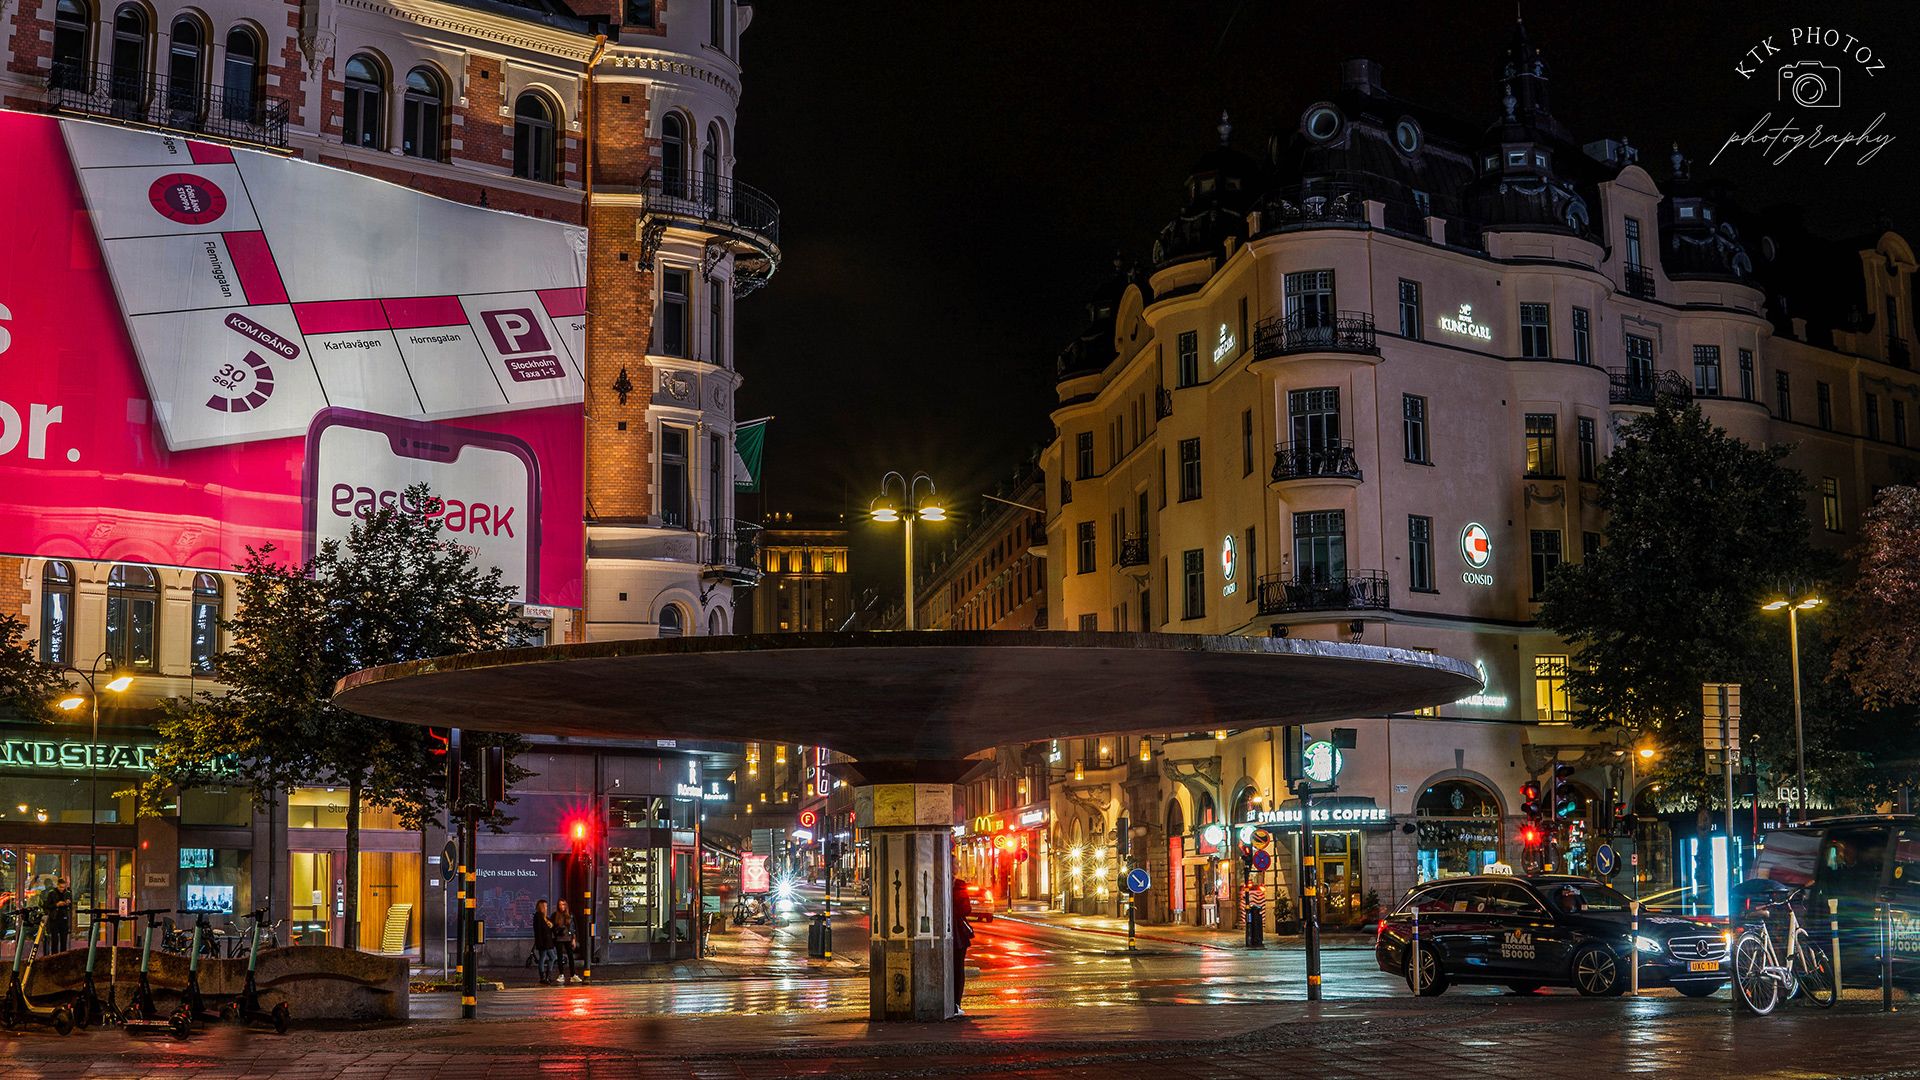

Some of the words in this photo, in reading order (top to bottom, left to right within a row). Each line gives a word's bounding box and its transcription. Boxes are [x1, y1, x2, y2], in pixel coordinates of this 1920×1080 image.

[177, 187, 192, 211] STOPPA
[204, 241, 232, 298] Fleminggatan
[230, 317, 259, 336] KOM
[494, 313, 531, 352] P
[1440, 317, 1467, 334] KUNG
[1468, 324, 1492, 340] CARL
[323, 339, 382, 350] Karlavägen
[409, 333, 461, 345] Hornsgatan
[510, 359, 556, 371] Stockholm
[219, 363, 247, 383] 30
[519, 369, 541, 379] Taxa
[540, 367, 556, 376] 1-5
[212, 375, 238, 391] sek
[1462, 572, 1493, 586] CONSID
[1258, 809, 1330, 823] STARBUKS
[1332, 808, 1387, 821] COFFEE
[497, 869, 516, 877] stans
[517, 868, 538, 877] bästa.
[1504, 932, 1532, 945] TAXI
[1501, 943, 1536, 951] STOCKHOLM
